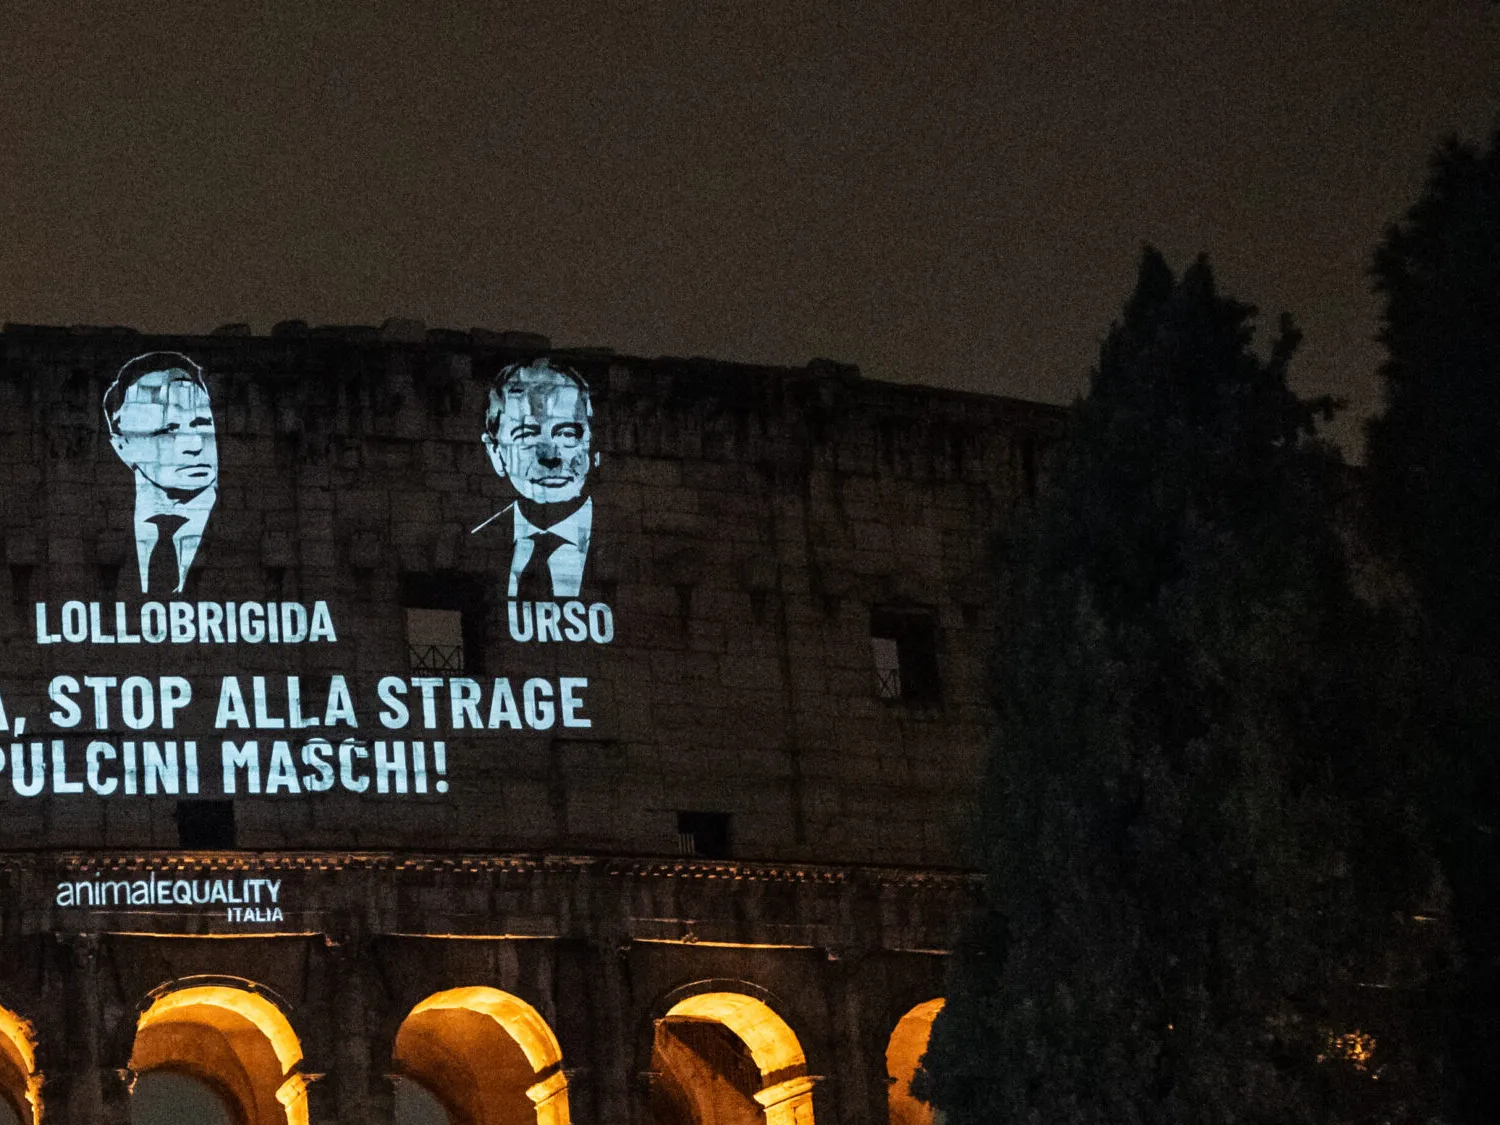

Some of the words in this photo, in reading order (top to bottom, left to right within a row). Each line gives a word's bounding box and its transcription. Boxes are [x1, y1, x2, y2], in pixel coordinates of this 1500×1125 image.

[36, 601, 339, 645] LOLLOBRIGIDA
[508, 600, 614, 644] URSO
[49, 675, 192, 730] STOP
[215, 675, 359, 729] ALLA
[376, 676, 592, 731] STRAGE
[222, 737, 450, 794] MASCHI!
[227, 907, 284, 923] ITALIA
